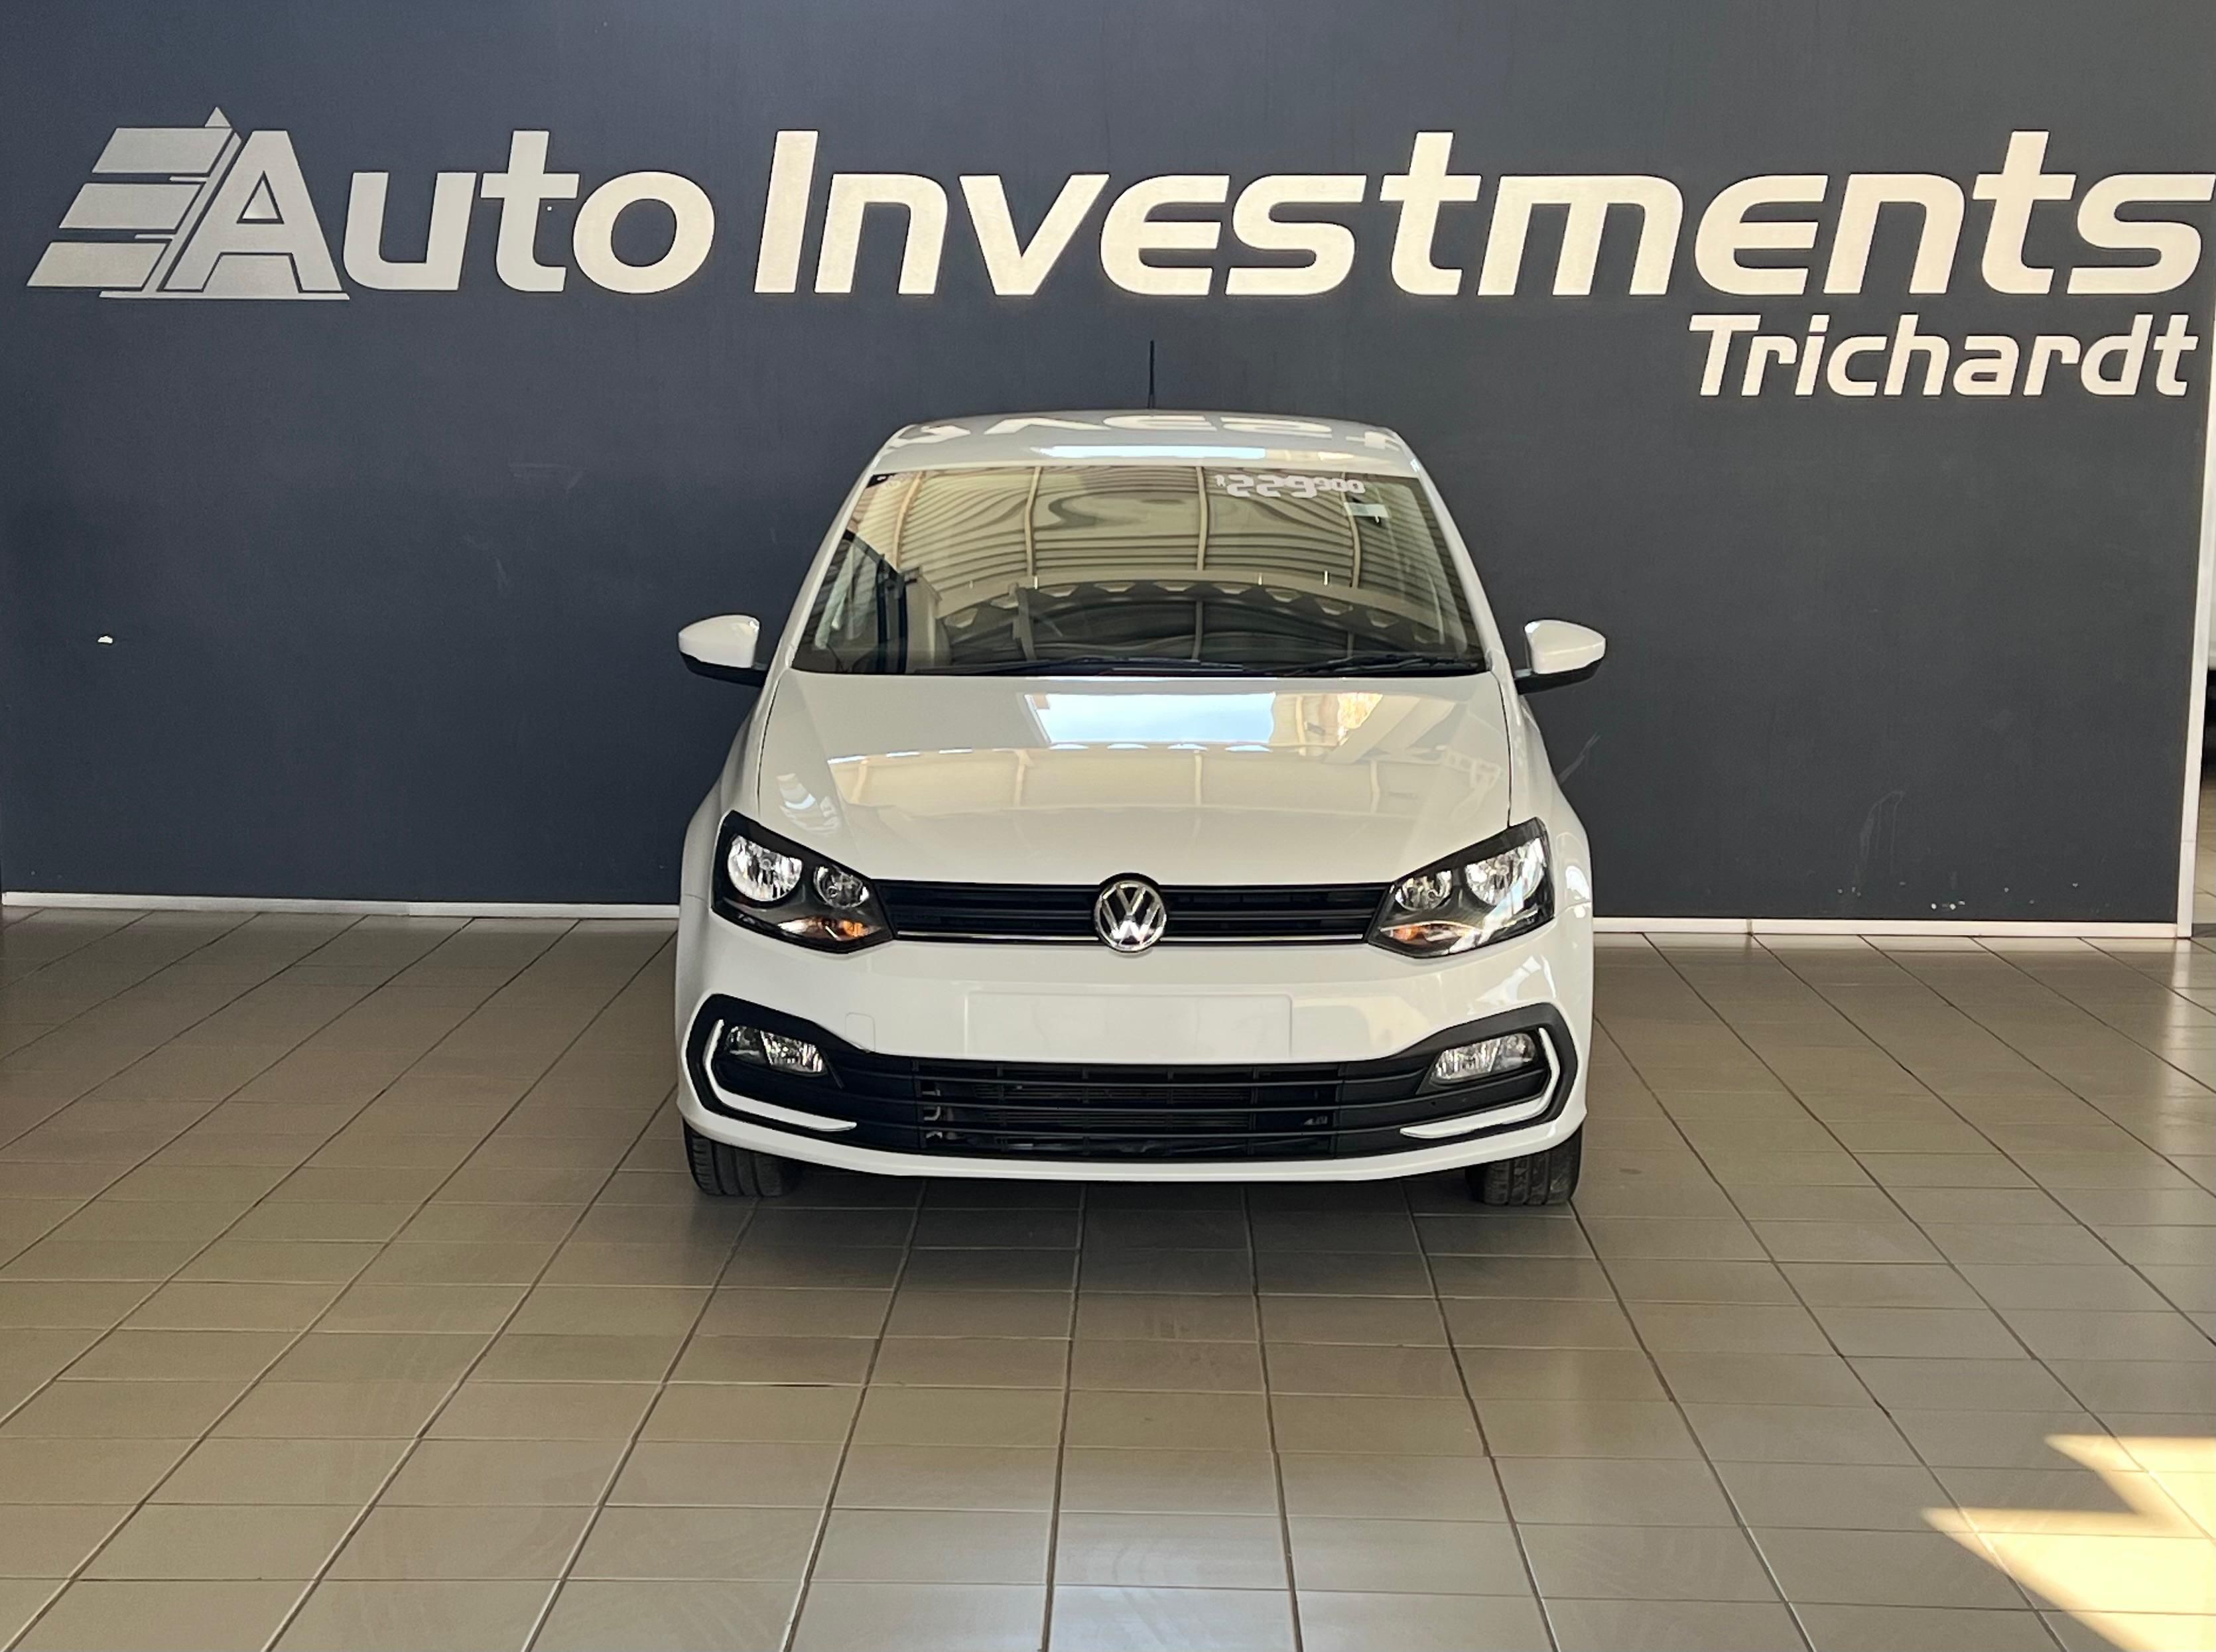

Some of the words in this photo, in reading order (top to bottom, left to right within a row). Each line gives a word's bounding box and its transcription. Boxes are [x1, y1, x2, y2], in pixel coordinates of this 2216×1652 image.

[164, 130, 715, 294] Auto
[754, 130, 2216, 296] Investments
[1689, 314, 2199, 397] Trichardt
